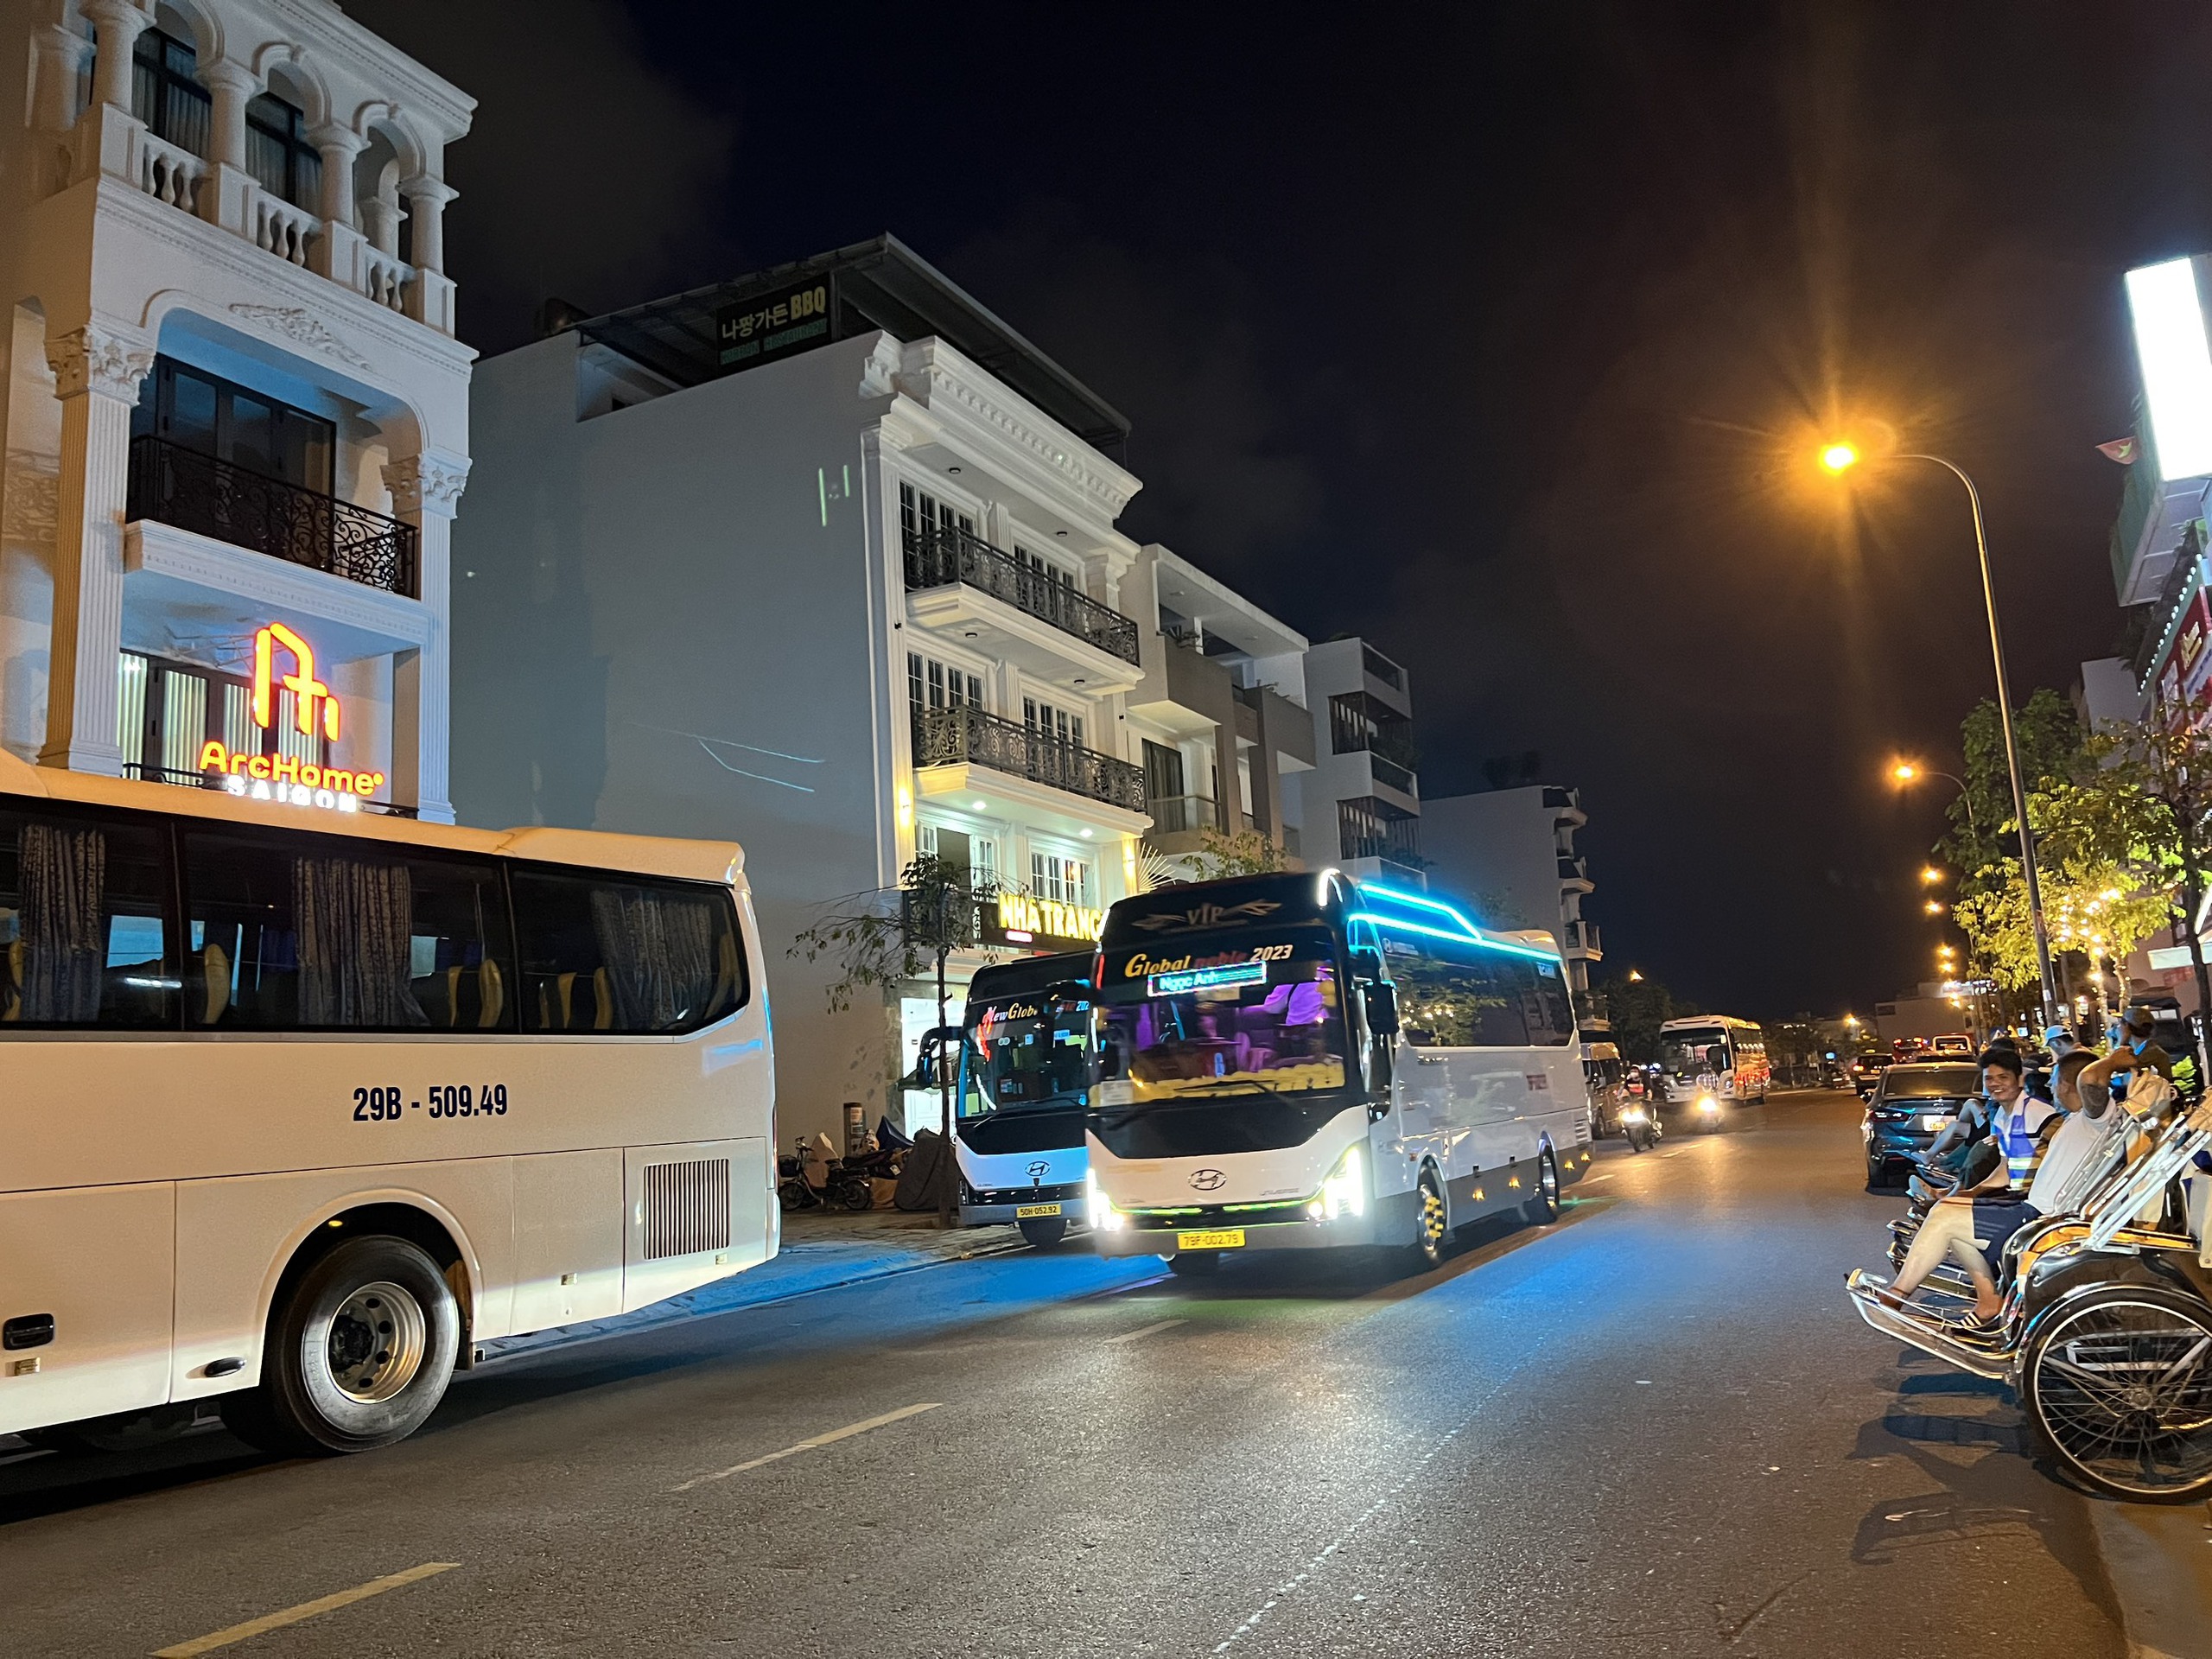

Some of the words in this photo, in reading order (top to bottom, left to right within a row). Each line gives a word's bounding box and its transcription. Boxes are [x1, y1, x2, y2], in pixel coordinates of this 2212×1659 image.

[791, 286, 826, 321] BBQ
[199, 741, 377, 796] ArcHome
[227, 775, 357, 812] SAIGON
[1000, 893, 1042, 934] NHA
[1039, 901, 1103, 942] TRANG
[1125, 953, 1191, 977] Global
[1249, 944, 1293, 962] 2023
[353, 1087, 402, 1121] 29B
[429, 1084, 507, 1118] 509.49
